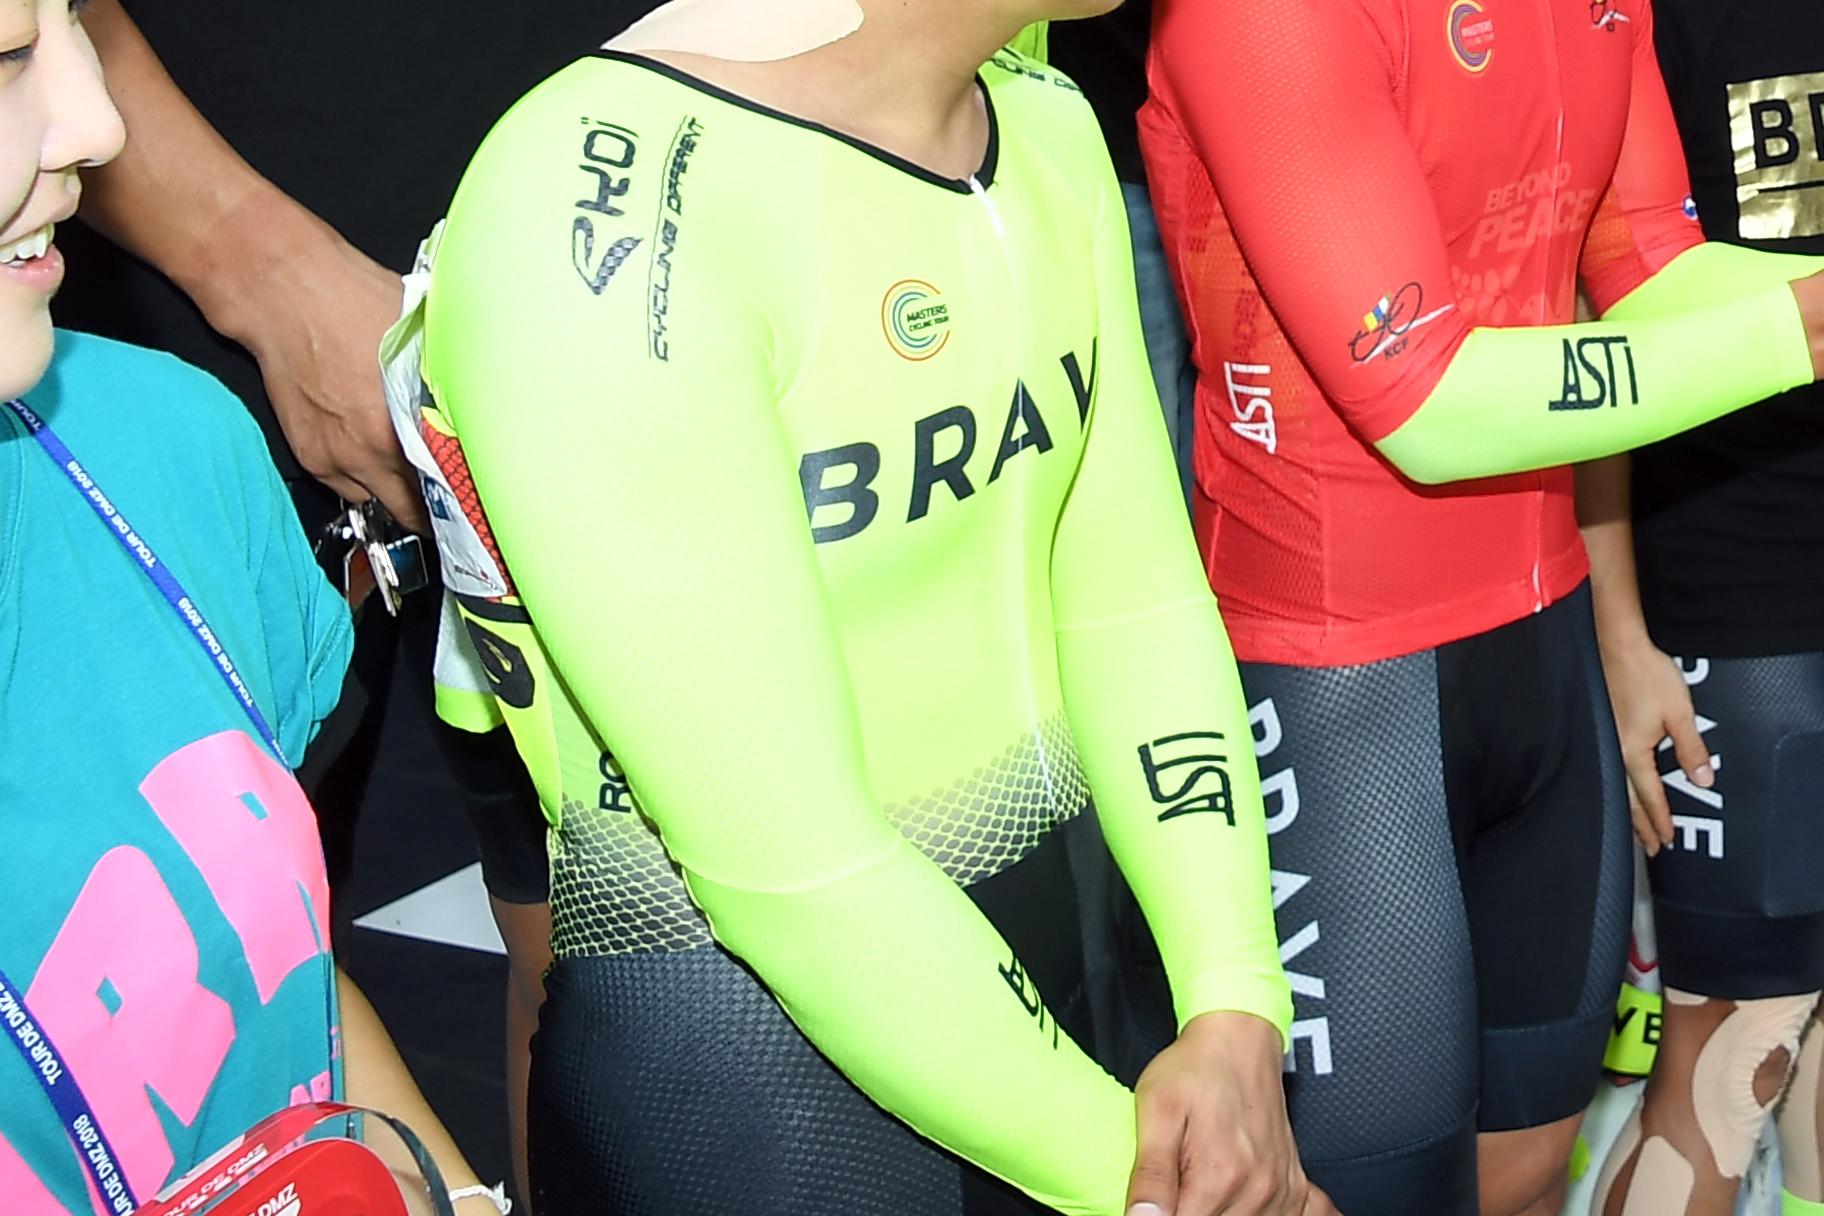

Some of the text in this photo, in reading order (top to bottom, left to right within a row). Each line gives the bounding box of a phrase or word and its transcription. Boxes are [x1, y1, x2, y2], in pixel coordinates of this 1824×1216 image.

[1484, 161, 1572, 215] BEYOND
[1468, 188, 1596, 259] PEACE
[906, 304, 948, 322] MASTERS
[798, 335, 1098, 545] BRAV
[67, 461, 157, 568] TOUR DE DMZ 2018
[178, 597, 254, 707] TOUR DE DMZ 2018
[0, 989, 63, 1086] TOUR DE DMZ
[73, 1113, 99, 1149] 2018
[87, 1141, 111, 1177] DMZ
[102, 1172, 123, 1199] DE
[256, 1181, 299, 1216] DMZ
